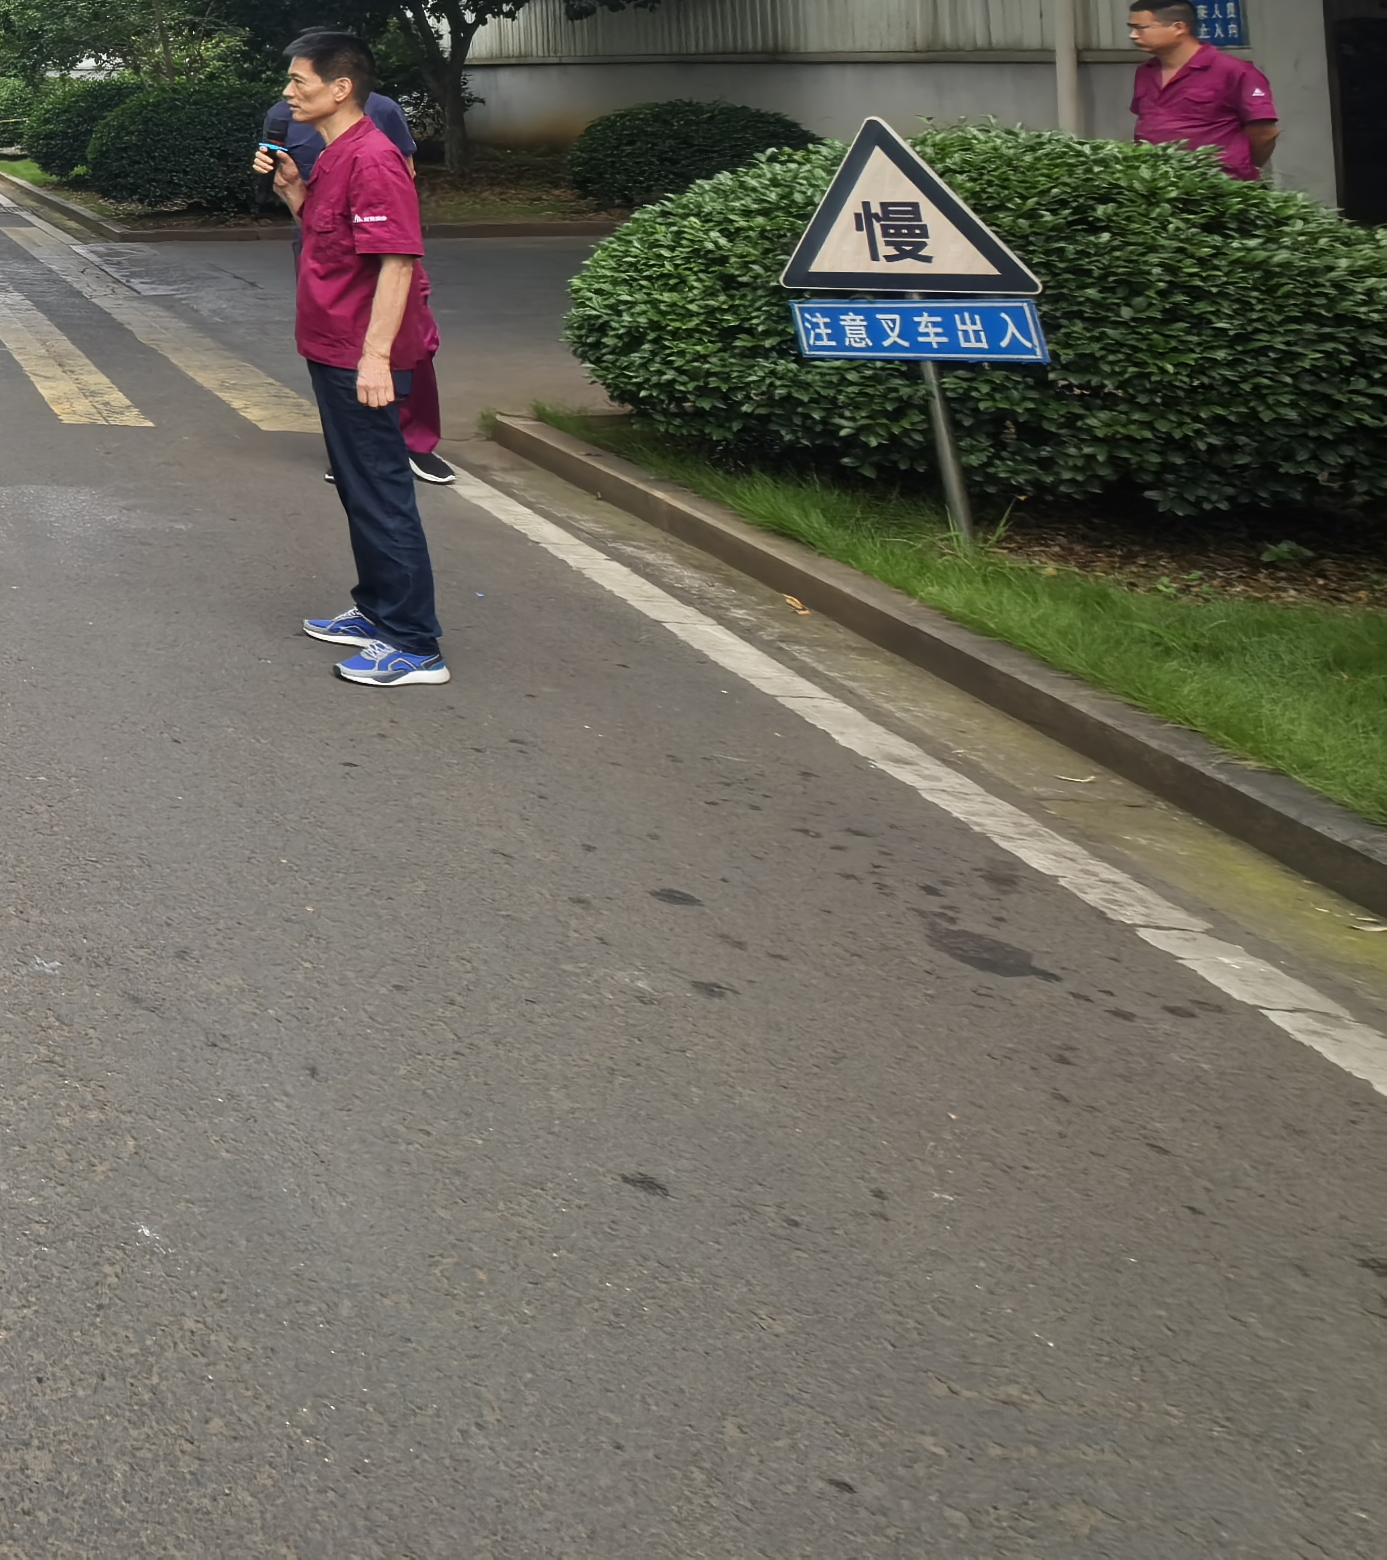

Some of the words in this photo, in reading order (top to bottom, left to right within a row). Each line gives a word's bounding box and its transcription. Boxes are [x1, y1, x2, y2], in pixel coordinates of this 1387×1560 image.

[853, 200, 934, 263] 慢
[804, 312, 1033, 349] 注意叉车出入
